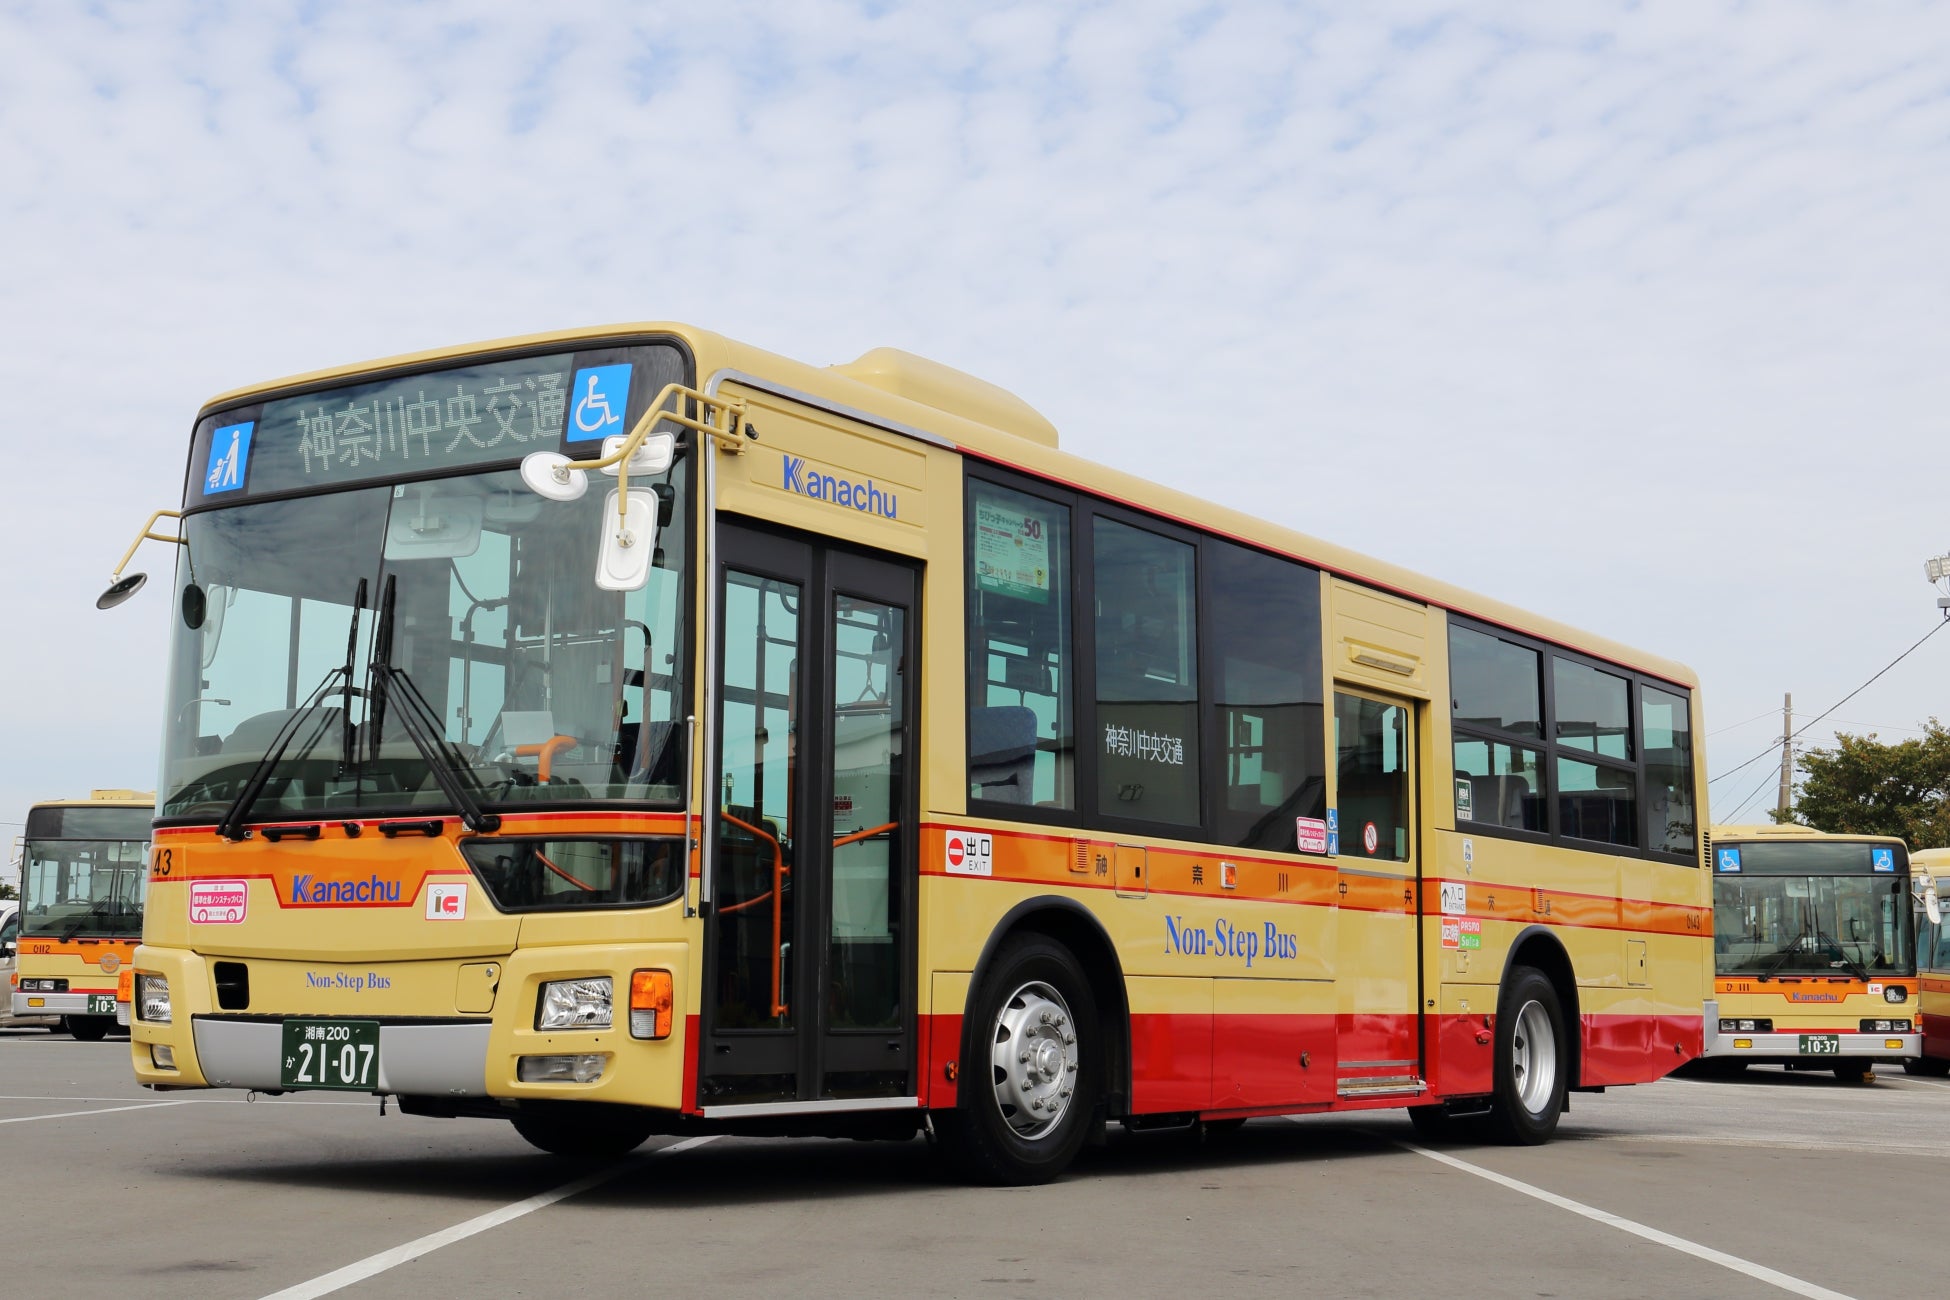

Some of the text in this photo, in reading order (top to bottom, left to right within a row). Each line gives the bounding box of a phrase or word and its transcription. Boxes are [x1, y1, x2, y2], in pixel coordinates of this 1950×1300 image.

[297, 373, 566, 474] 神奈川中央交通
[783, 454, 897, 519] Kanachu
[1105, 723, 1184, 766] 神奈川中央交通
[966, 836, 990, 857] 出口
[968, 860, 987, 872] EXIT
[292, 874, 402, 903] Kanachu
[1450, 886, 1464, 901] 入口
[1164, 914, 1298, 968] Non-Step Bus
[306, 971, 392, 993] Non-Step Bus
[95, 1000, 117, 1013] 10-3
[1792, 992, 1838, 1001] Kanachu
[1807, 1040, 1838, 1053] 10-37
[285, 1056, 296, 1069] か
